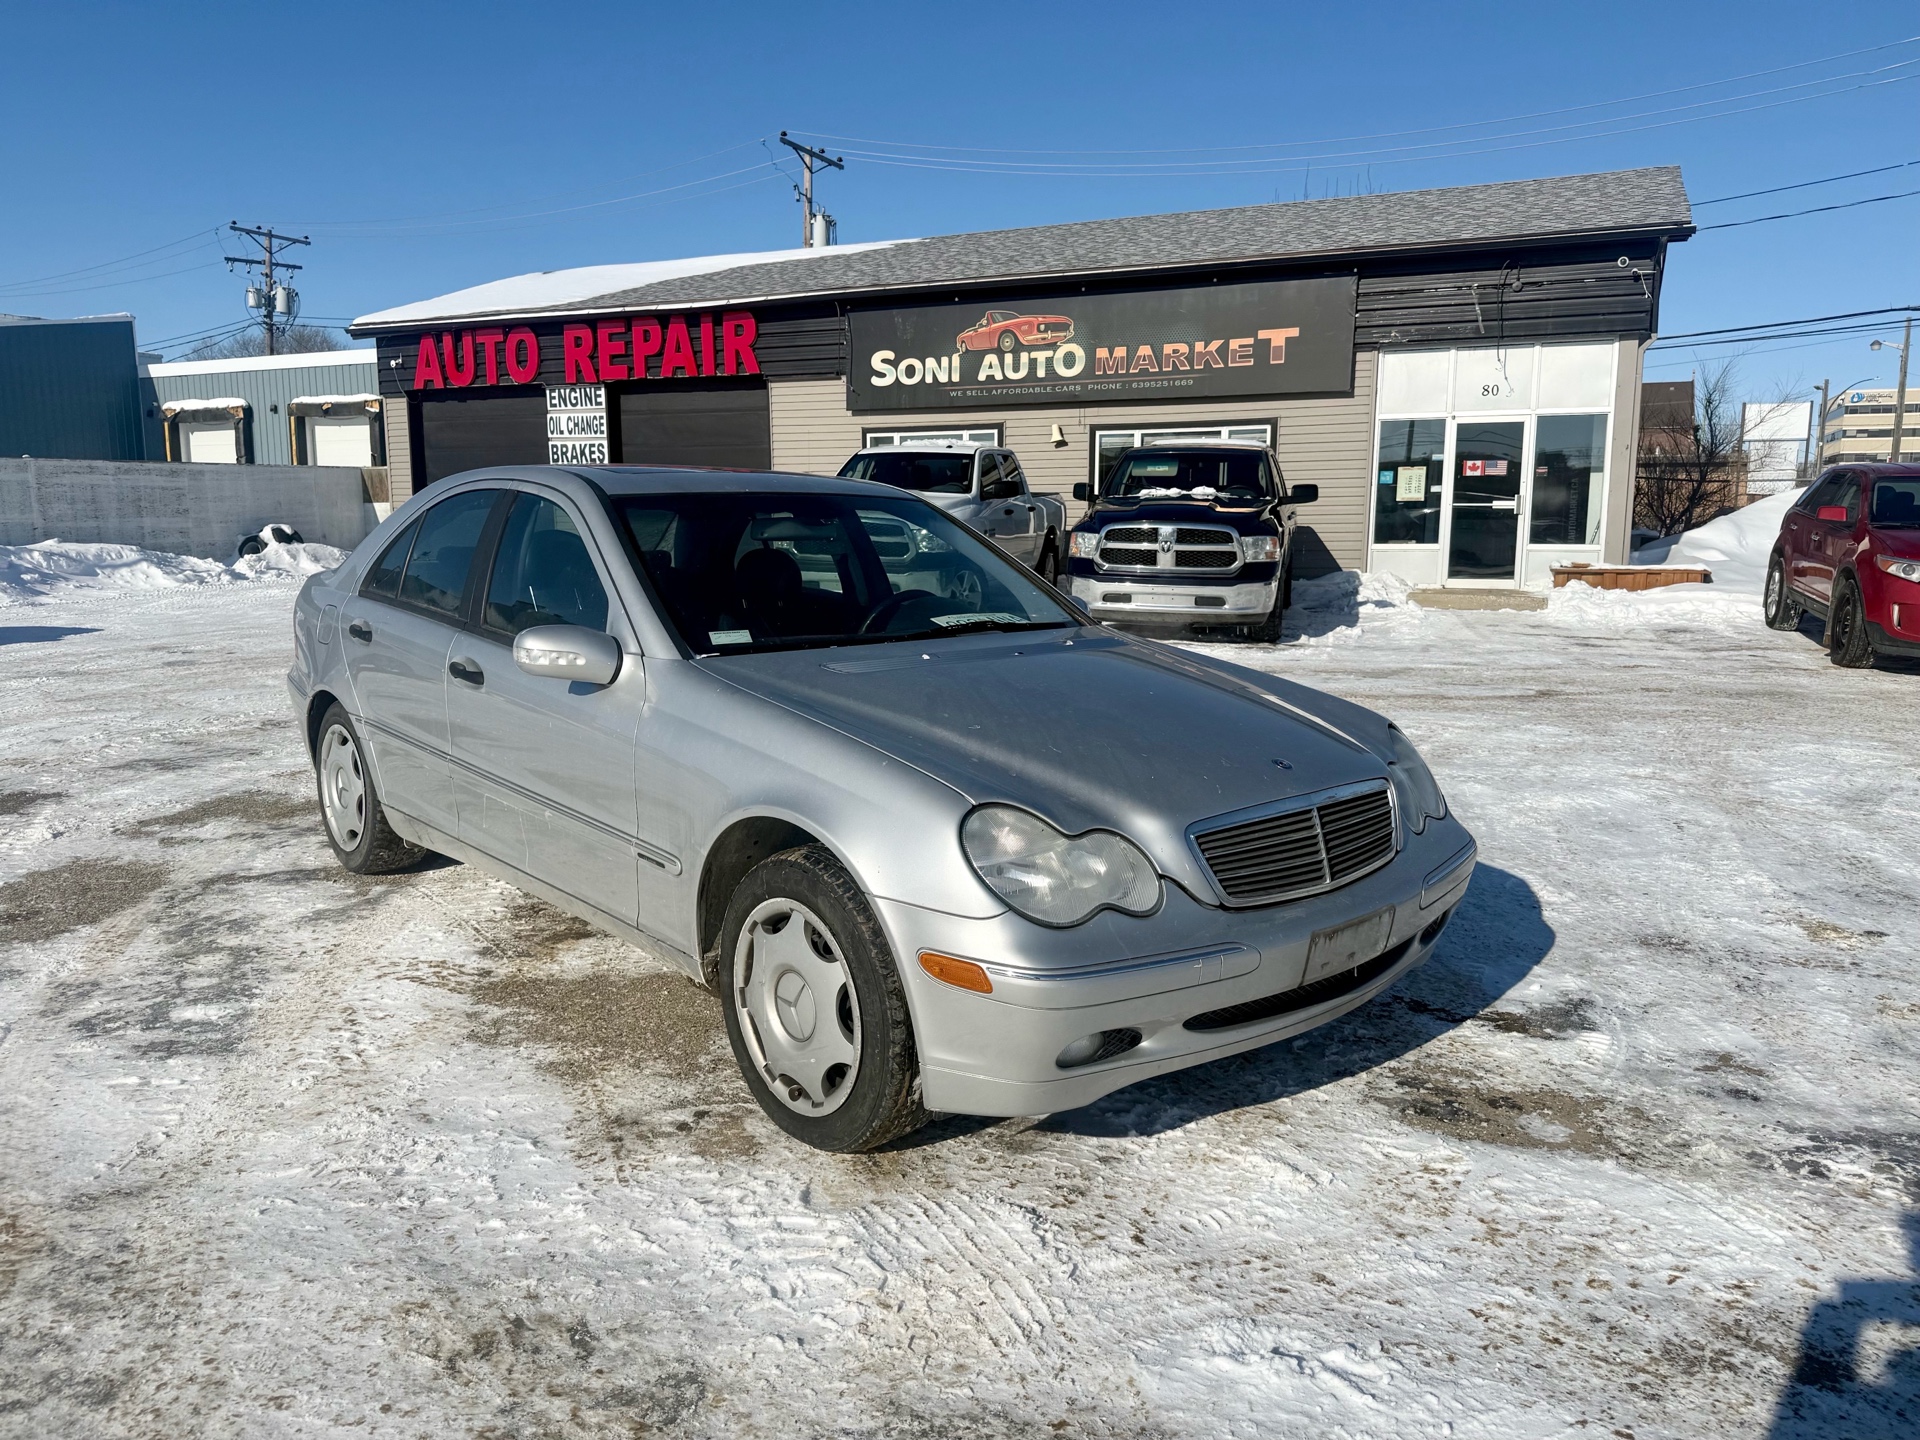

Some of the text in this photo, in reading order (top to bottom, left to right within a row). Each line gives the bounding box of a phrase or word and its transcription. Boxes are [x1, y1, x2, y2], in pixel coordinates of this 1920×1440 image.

[414, 310, 762, 390] AUTO REPAIR
[870, 327, 1300, 387] SONI AUTO MARKET
[548, 387, 603, 408] ENGINE
[991, 386, 1052, 395] AFFORDABLE
[1055, 384, 1081, 392] CARS
[1088, 382, 1122, 391] PHONE
[1131, 379, 1194, 389] 6395251669
[1481, 384, 1499, 397] 80
[549, 415, 605, 436] OIL CHANGE
[550, 443, 606, 464] BRAKES
